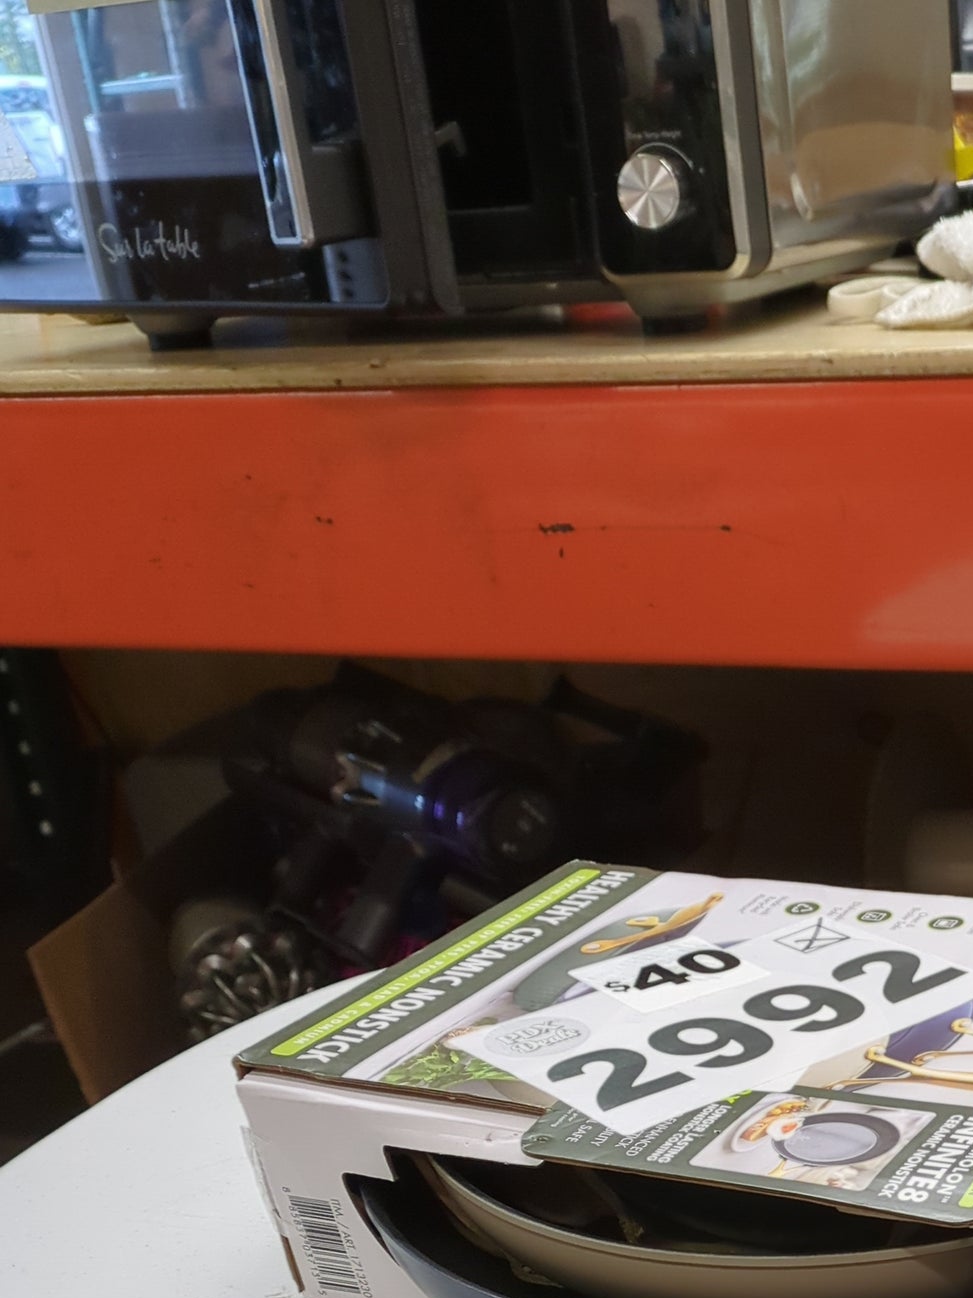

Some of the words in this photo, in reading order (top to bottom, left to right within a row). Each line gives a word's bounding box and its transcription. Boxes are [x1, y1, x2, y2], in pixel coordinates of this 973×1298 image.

[534, 870, 636, 926] HEALTHY
[429, 926, 543, 987] CERAMIC
[604, 949, 741, 993] $40
[293, 1009, 358, 1045] CADMIUM
[296, 986, 445, 1064] NONSTICK
[546, 949, 968, 1112] 2992
[565, 1124, 593, 1143] SAFE
[678, 1103, 720, 1132] NONSTICK
[692, 1104, 733, 1132] LONGER
[921, 1114, 965, 1149] CERAMIC
[646, 1132, 683, 1162] COATING
[657, 1132, 704, 1164] LASTING
[878, 1148, 930, 1199] NONSTICK
[350, 1255, 373, 1298] 1713230
